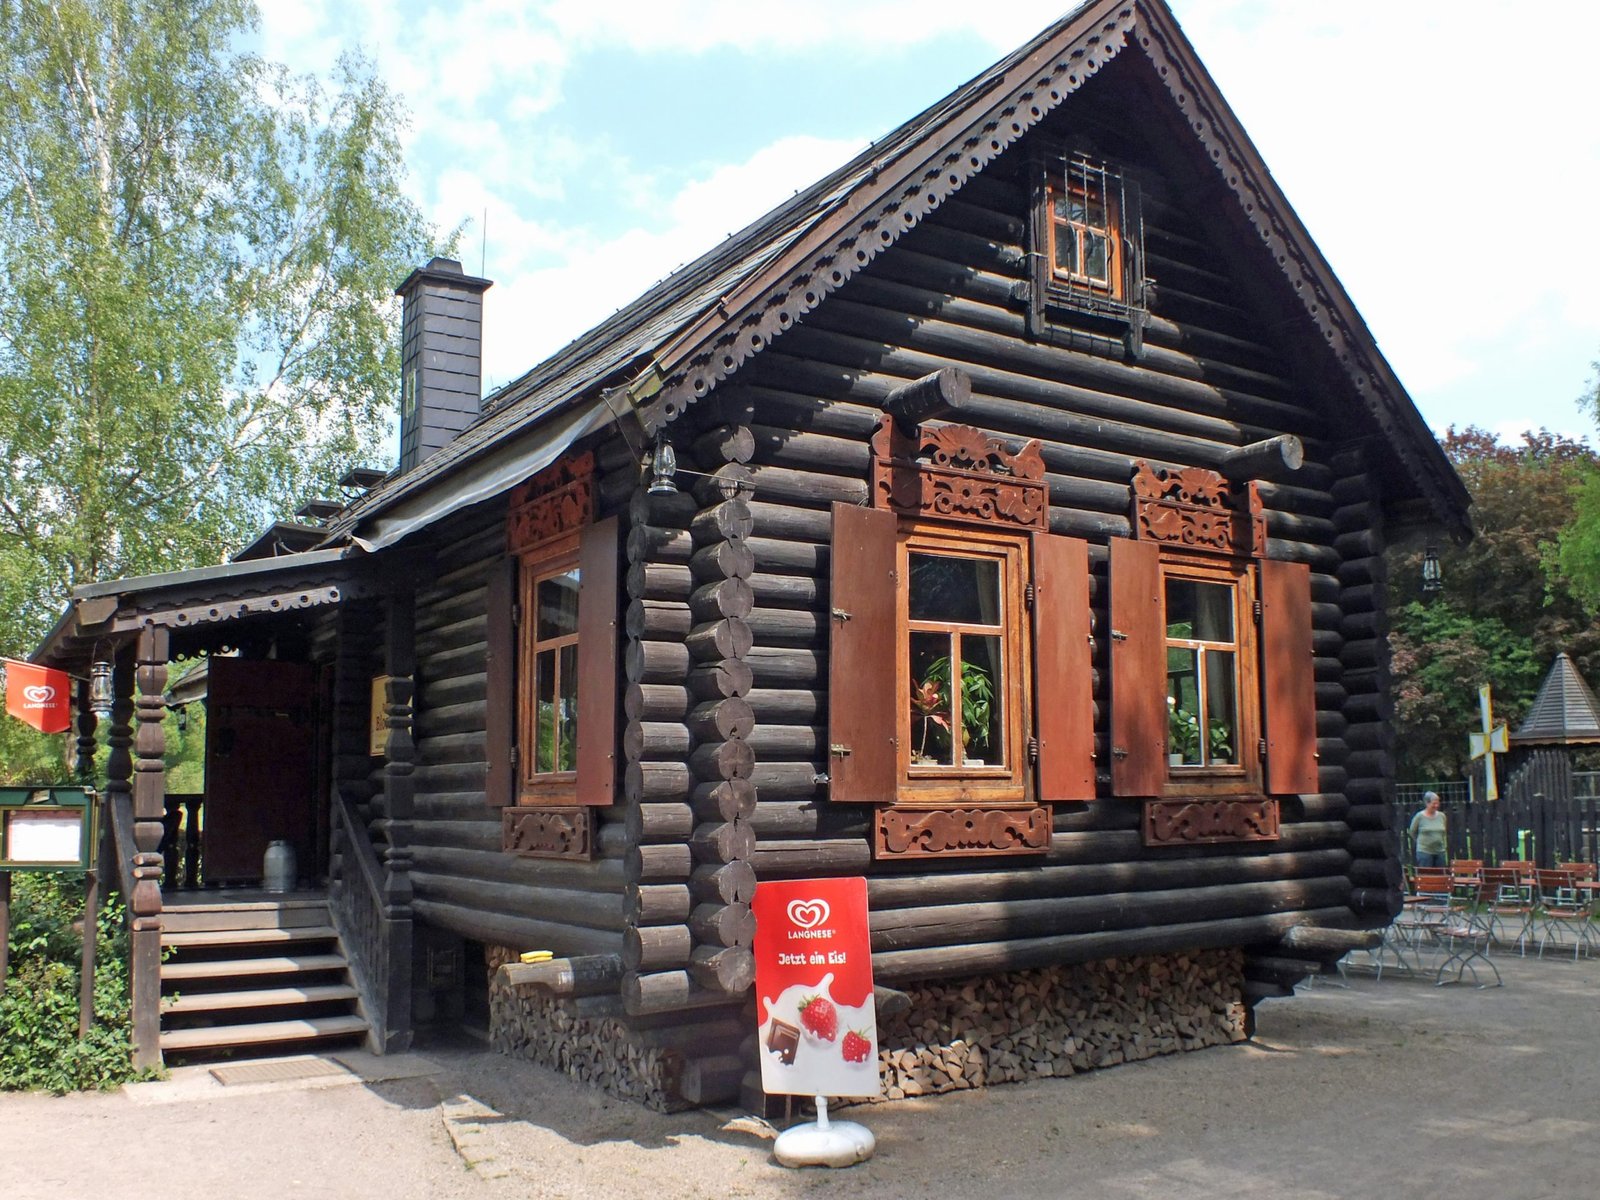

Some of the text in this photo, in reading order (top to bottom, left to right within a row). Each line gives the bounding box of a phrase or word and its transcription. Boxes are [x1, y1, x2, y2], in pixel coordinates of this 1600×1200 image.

[788, 929, 832, 939] LANGNESE
[778, 950, 846, 965] Jetzt ein Eis!
